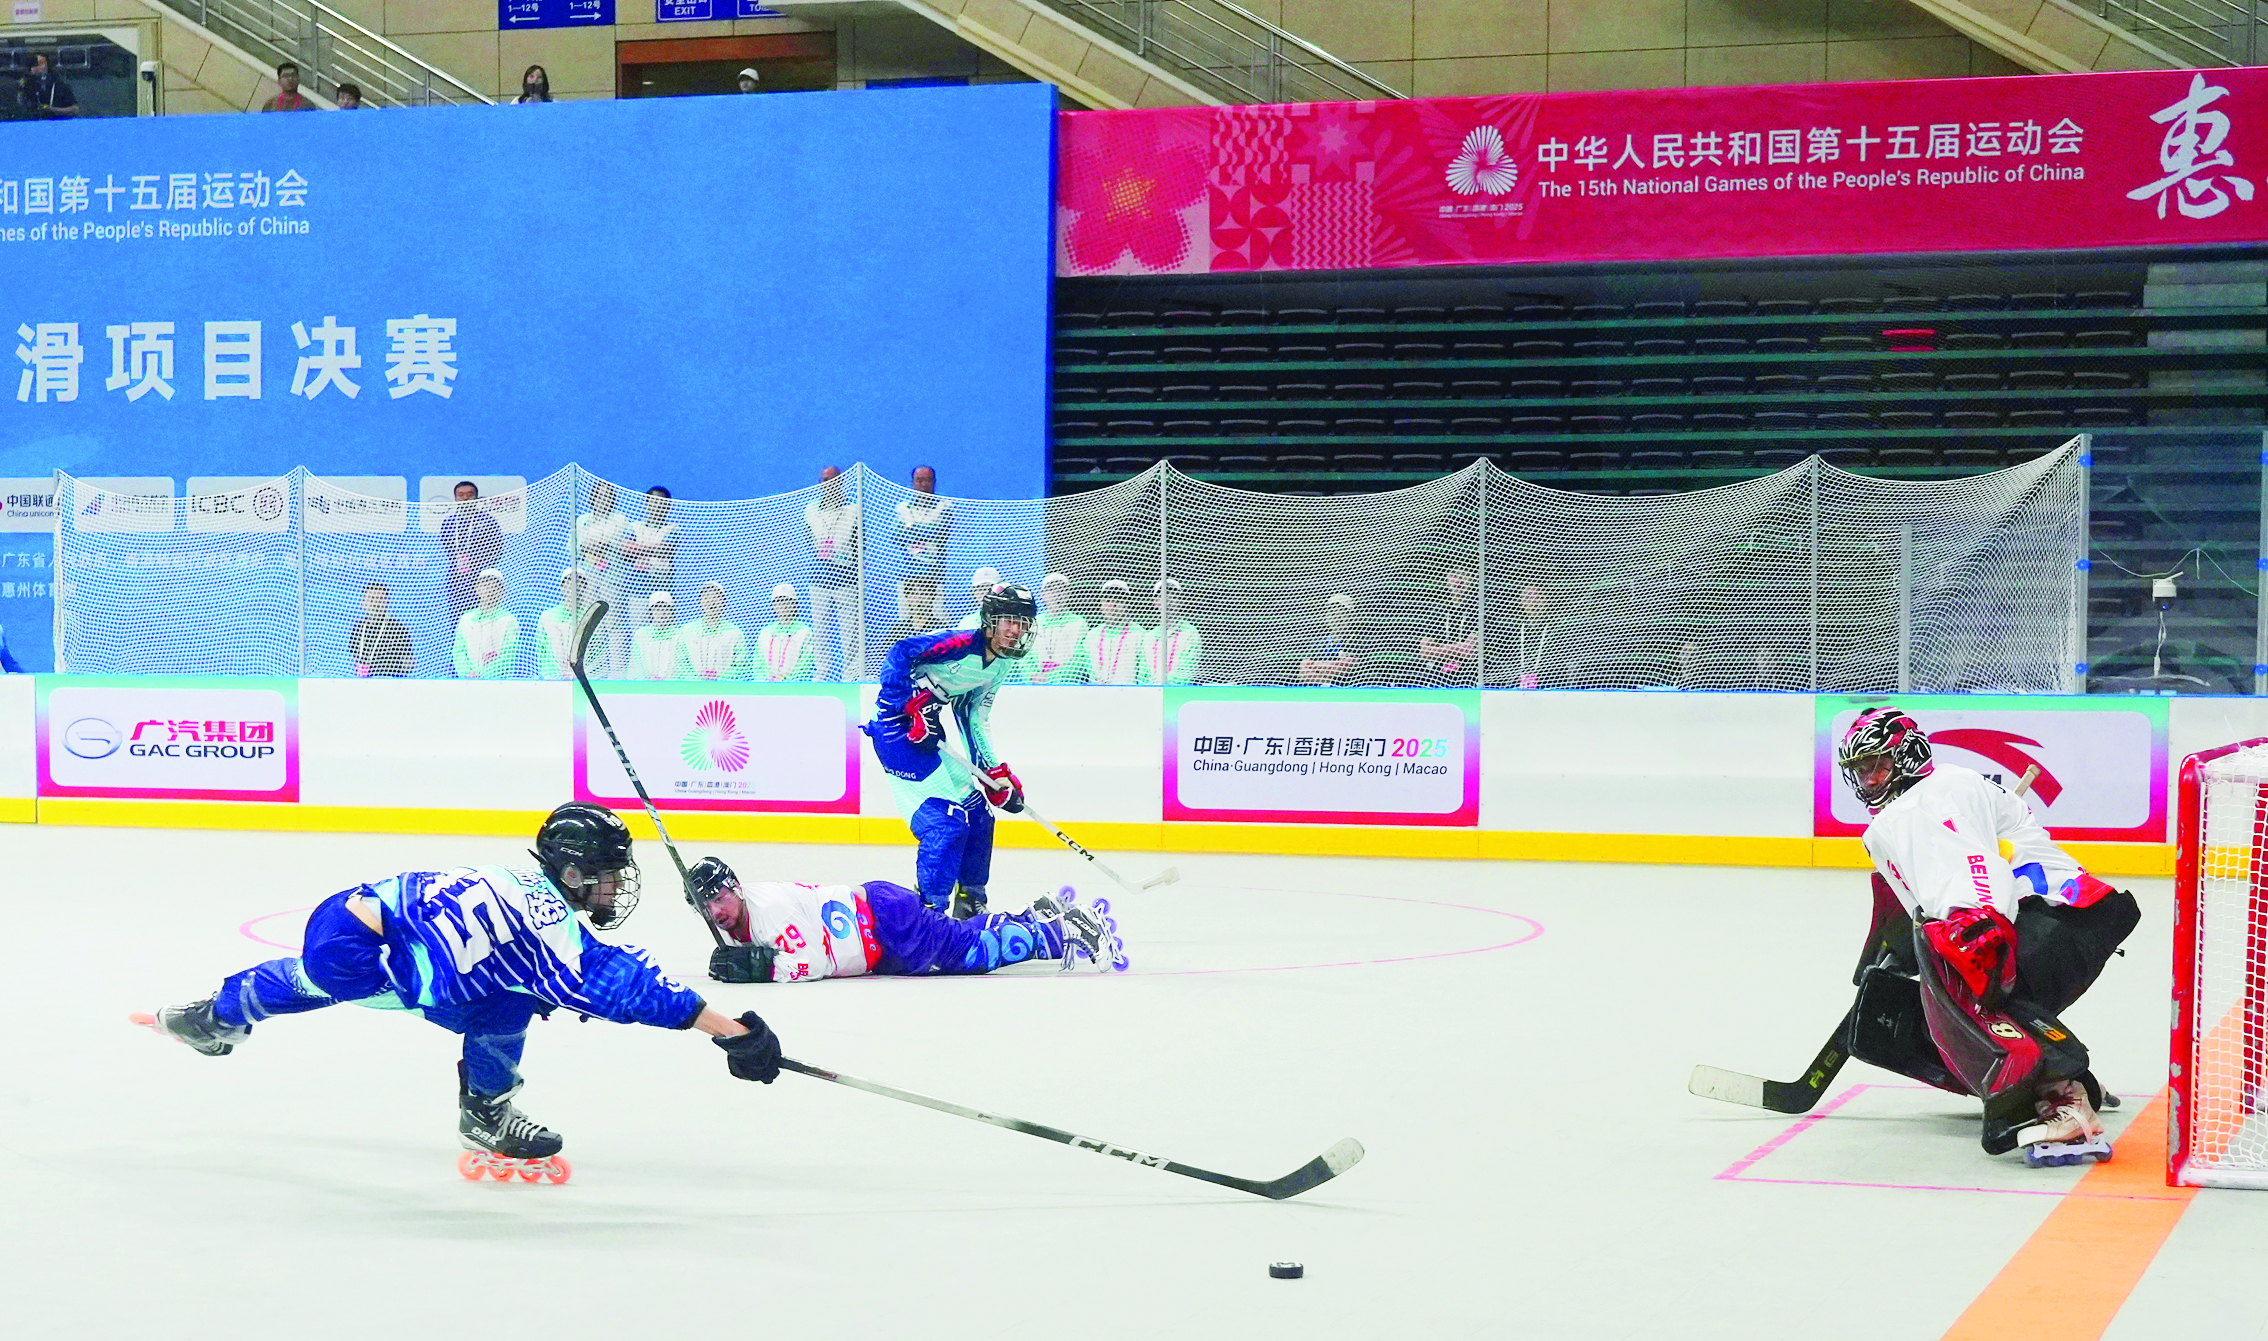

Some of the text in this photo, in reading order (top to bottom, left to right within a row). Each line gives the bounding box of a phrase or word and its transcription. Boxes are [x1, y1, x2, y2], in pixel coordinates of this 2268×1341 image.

[674, 6, 696, 16] EXIT
[1537, 118, 2085, 173] 中华人民共和国第十五届运动会
[0, 169, 309, 215] 和国第十五届运动会
[1538, 162, 2085, 198] The 15th National Games of the People's Republic of China
[30, 223, 48, 241] of
[52, 221, 78, 240] the
[84, 220, 154, 243] People's
[159, 217, 233, 240] Republic
[237, 216, 256, 236] of
[260, 215, 310, 236] China
[15, 313, 459, 403] 滑项目决赛
[130, 719, 274, 743] 广汽集团
[129, 744, 275, 759] GAC GROUP
[1391, 738, 1448, 758] 2025
[1320, 761, 1355, 777] Hong
[1358, 762, 1392, 777] Kong
[1403, 762, 1448, 776] Macao
[1055, 830, 1096, 862] CCM
[1068, 1136, 1170, 1170] CCM
